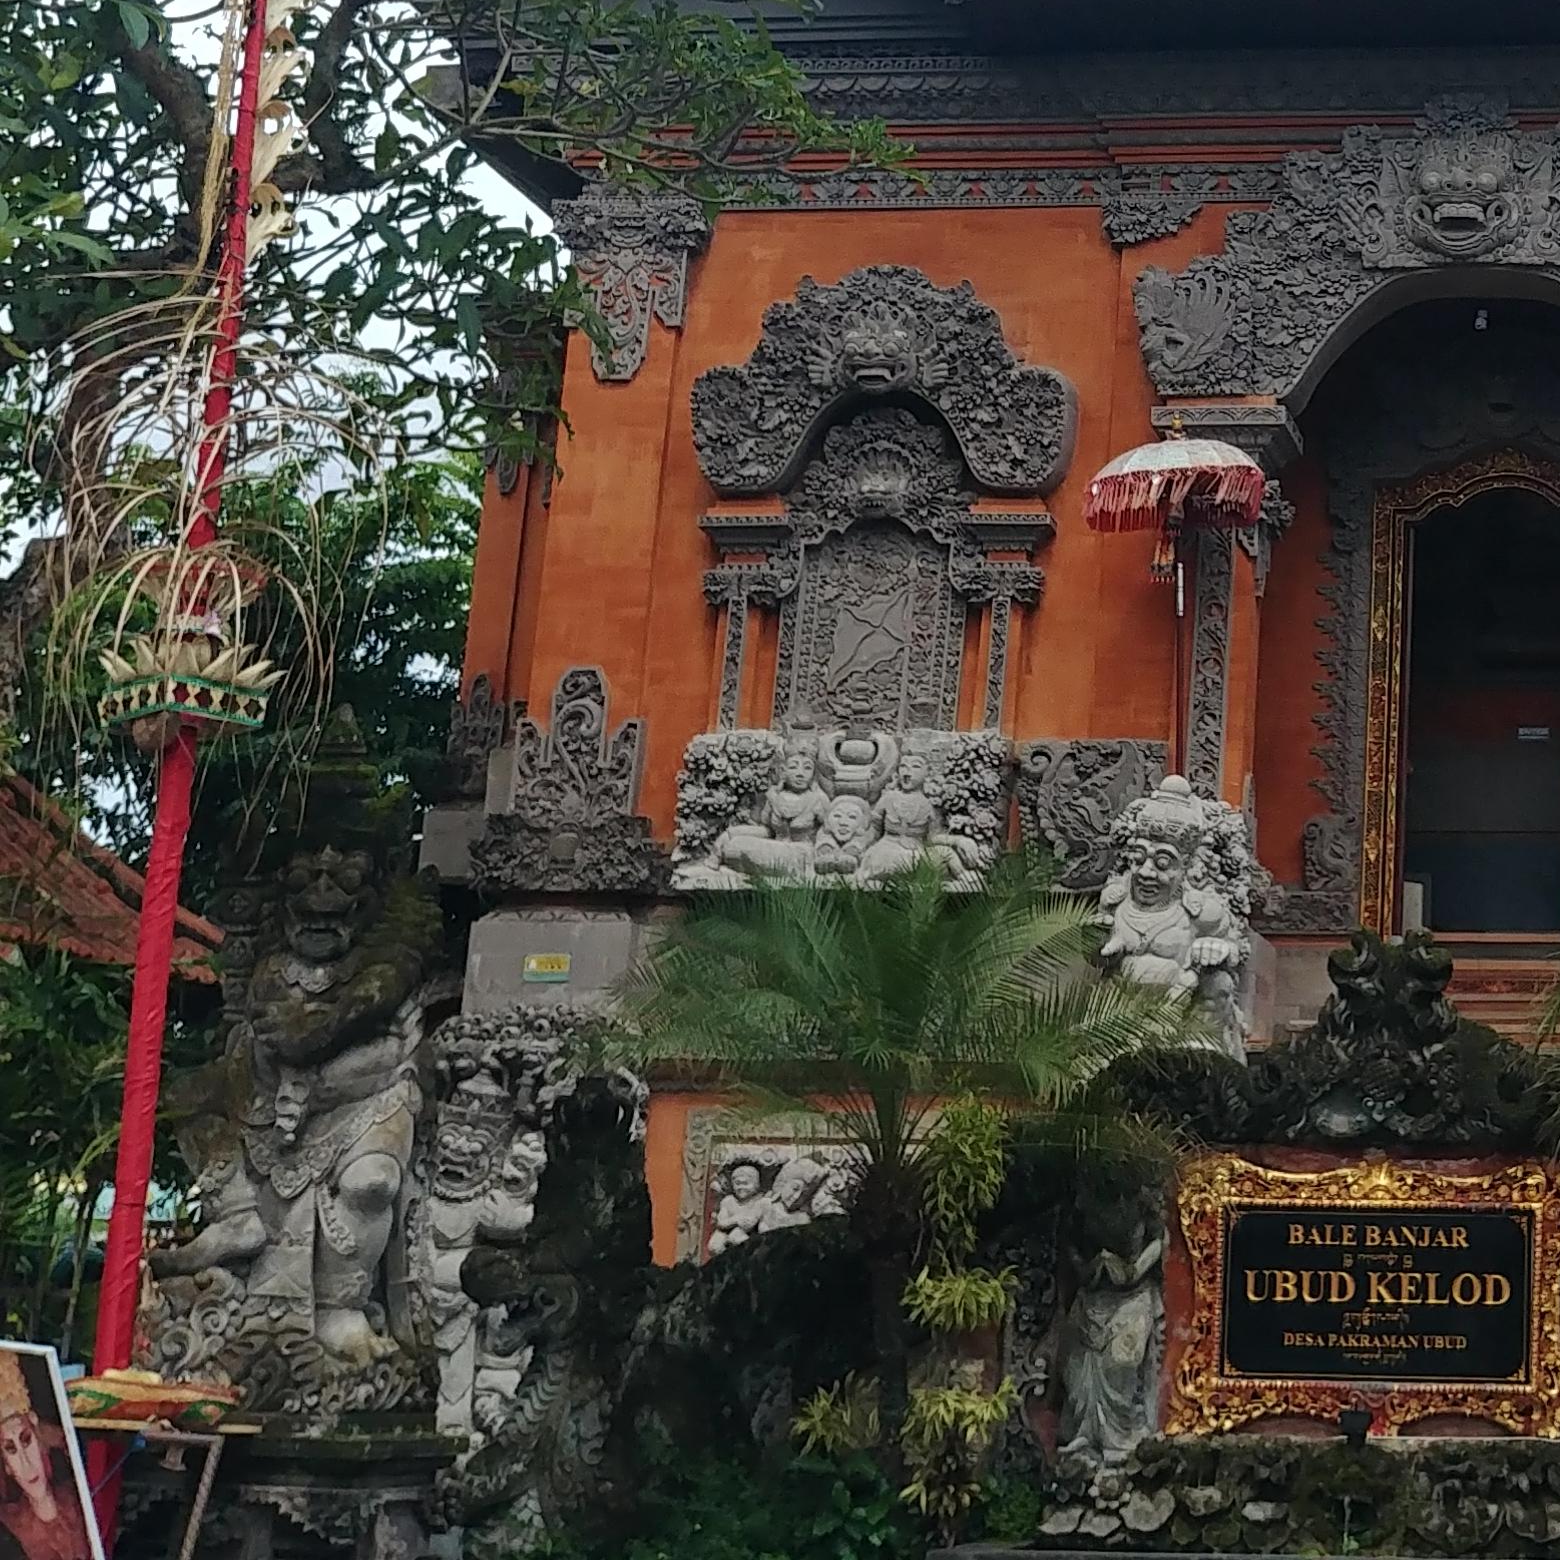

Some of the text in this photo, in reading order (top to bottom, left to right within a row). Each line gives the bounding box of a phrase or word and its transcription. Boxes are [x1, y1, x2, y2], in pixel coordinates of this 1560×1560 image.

[1288, 1223, 1469, 1248] BALE BANJAR
[1243, 1269, 1511, 1306] UBUD KELOD
[1283, 1331, 1467, 1350] DESA PAKRAMAN UBUD
